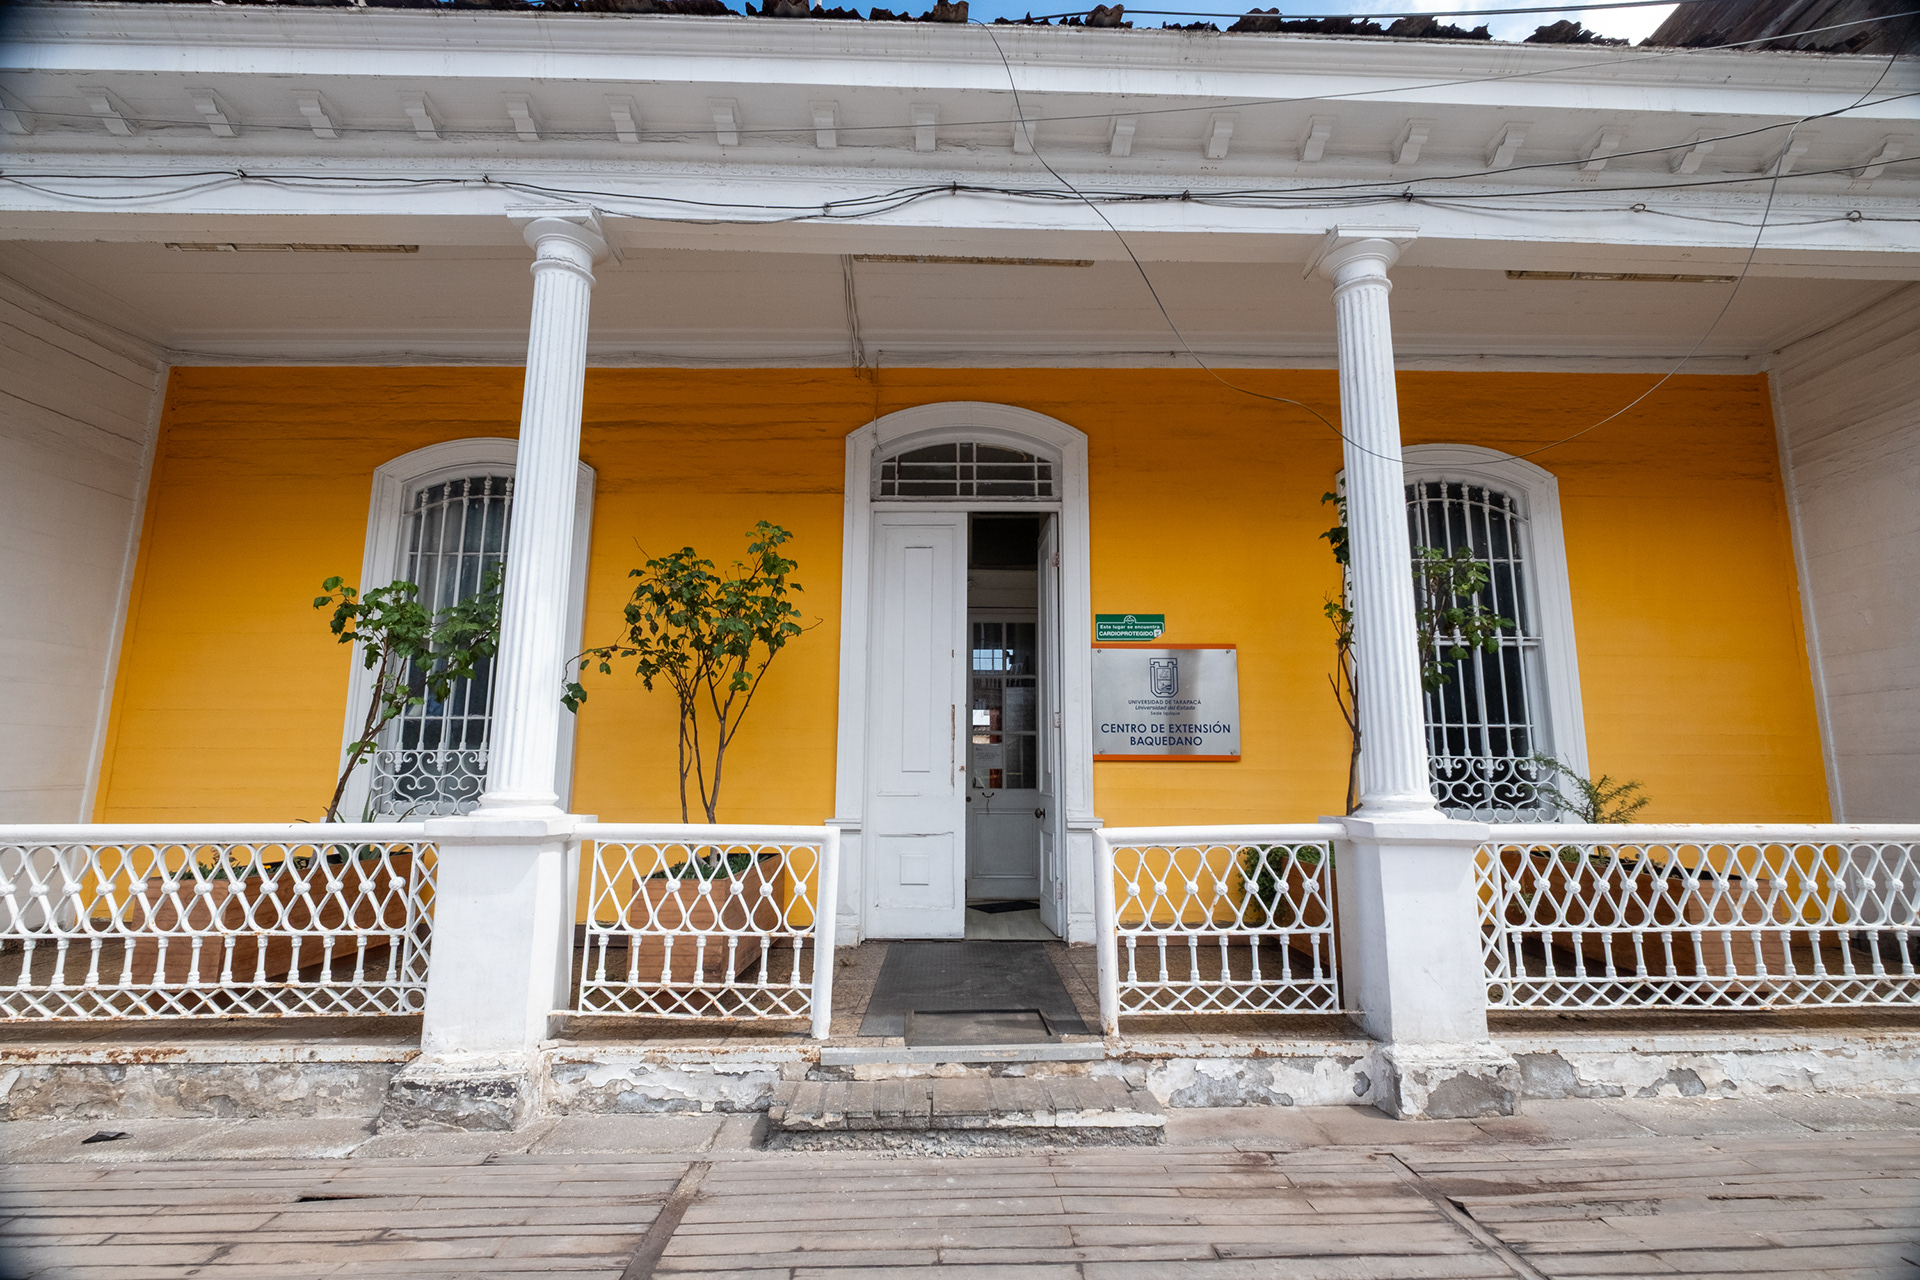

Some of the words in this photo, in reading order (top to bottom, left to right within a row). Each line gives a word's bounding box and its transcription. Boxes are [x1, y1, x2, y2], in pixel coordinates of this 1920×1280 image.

[1101, 724, 1147, 733] CENTRO
[1151, 724, 1164, 733] DE
[1170, 721, 1230, 733] EXTENSIÓN
[1130, 736, 1202, 746] BAQUEDANO
